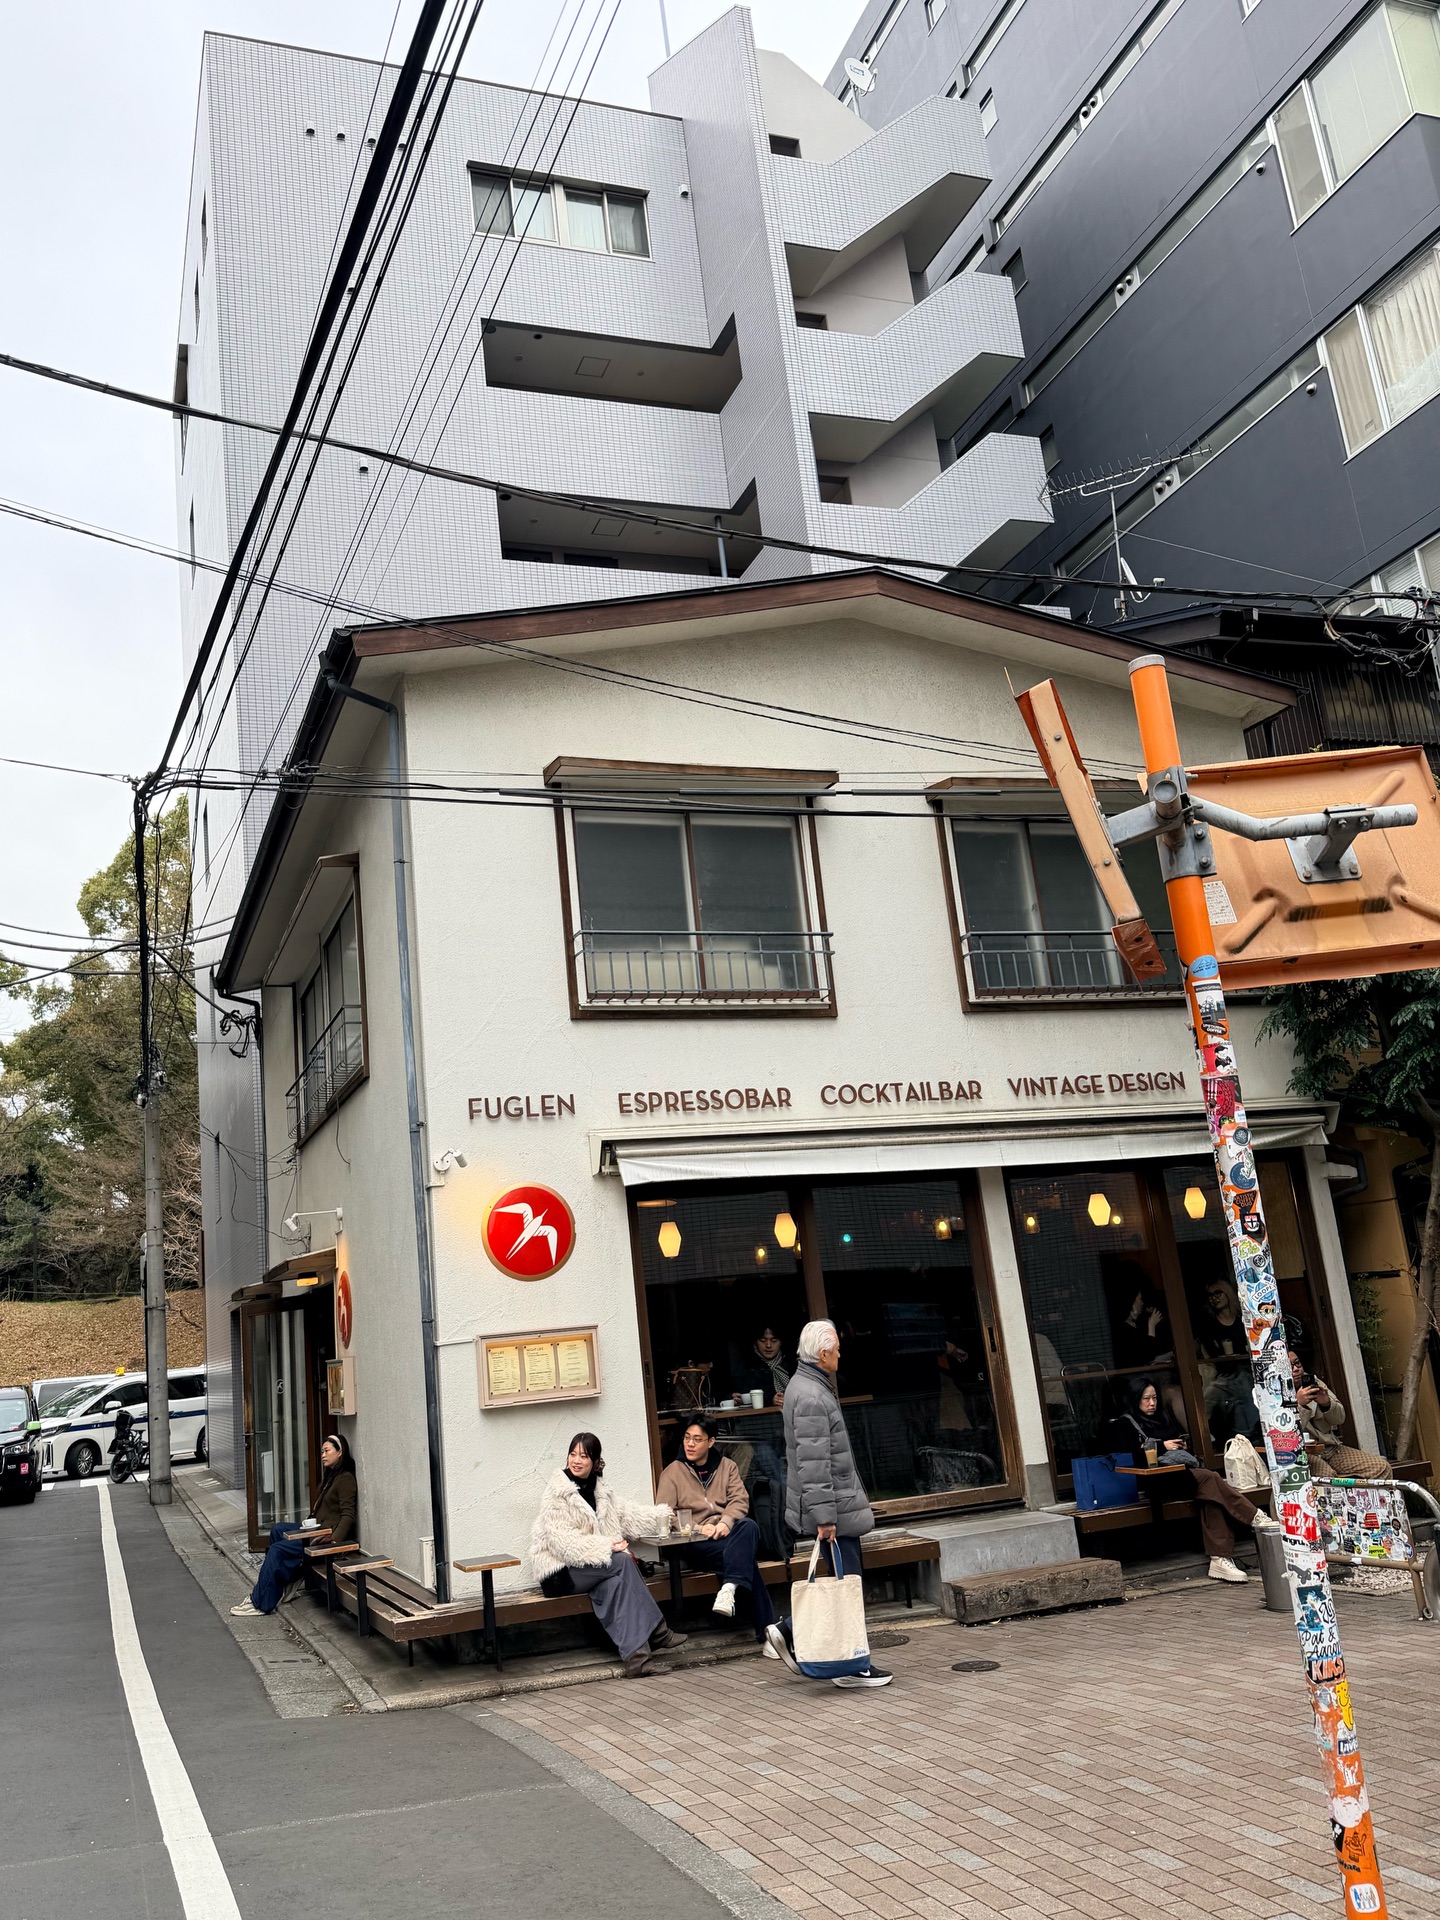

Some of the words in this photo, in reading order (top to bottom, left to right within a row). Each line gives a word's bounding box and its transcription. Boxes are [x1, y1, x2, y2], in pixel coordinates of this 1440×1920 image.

[467, 1093, 576, 1120] FUGLEN
[618, 1087, 792, 1114] ESPRESSOBAR
[820, 1080, 982, 1106] COCKTAILBAR
[1007, 1074, 1105, 1098] VINTAGE
[1108, 1071, 1186, 1094] DESIGN
